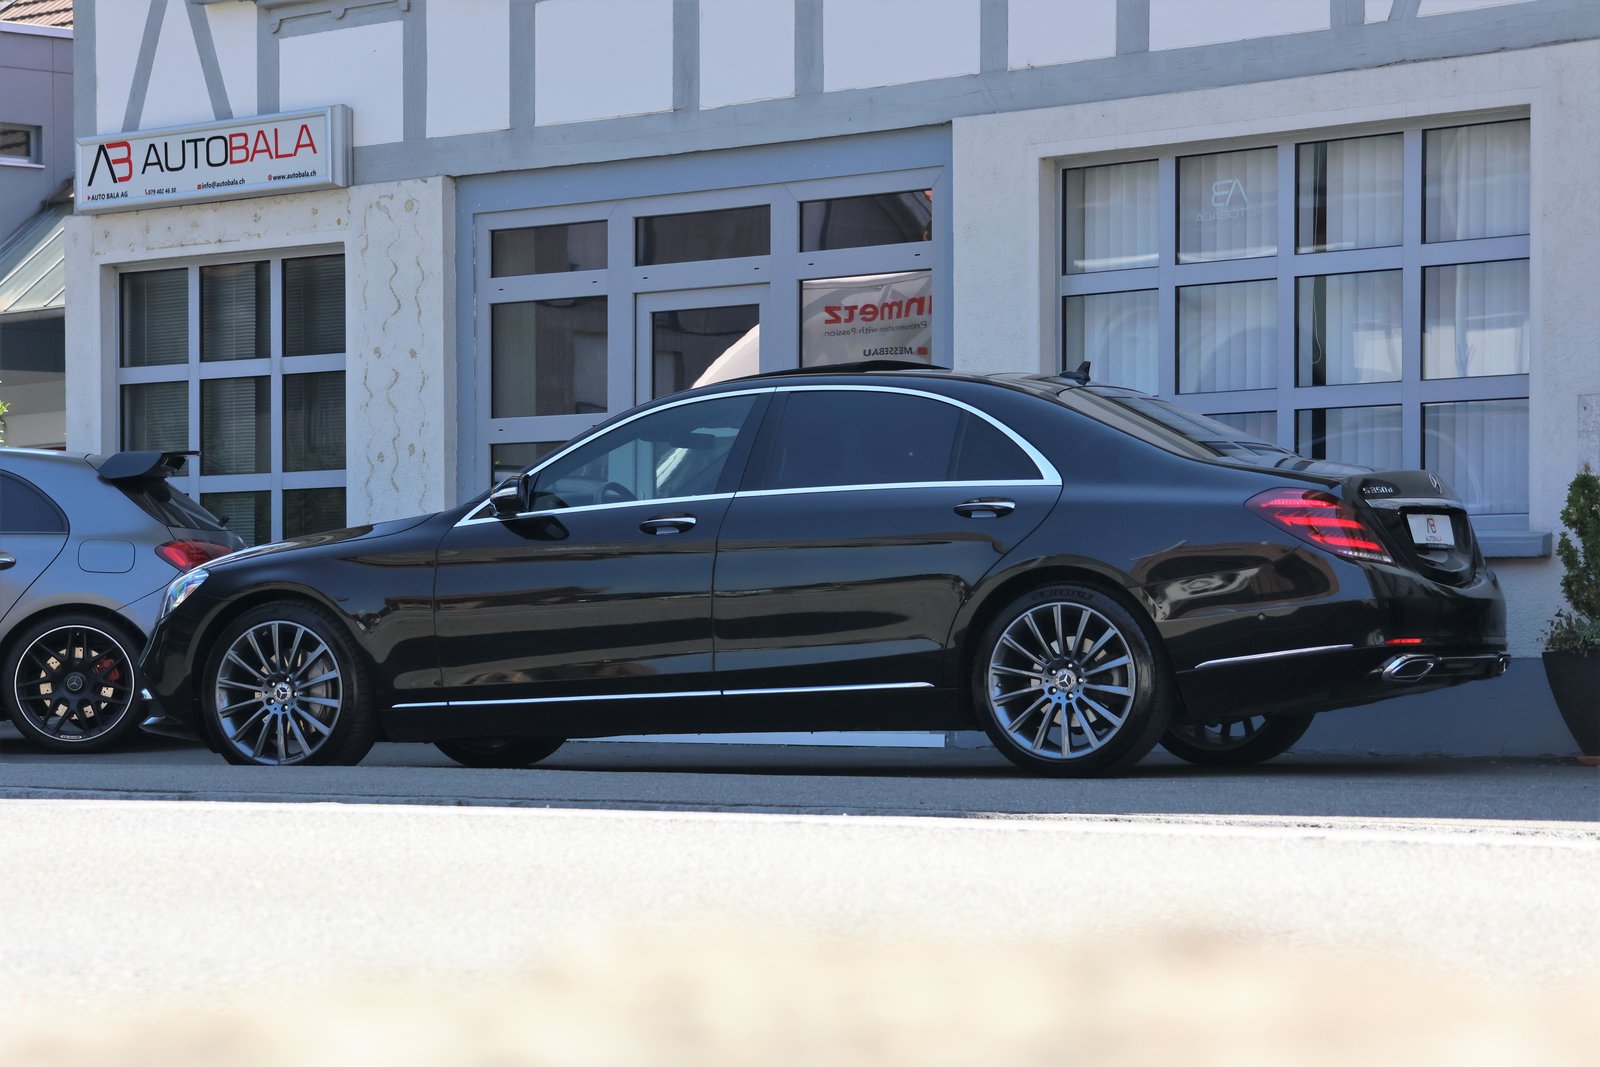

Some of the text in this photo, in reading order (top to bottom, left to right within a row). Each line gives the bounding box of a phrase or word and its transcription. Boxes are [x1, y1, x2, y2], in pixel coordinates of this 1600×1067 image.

[141, 124, 317, 175] AUTOBALA
[272, 170, 317, 181] www.autobala.ch
[201, 178, 246, 189] info@autobala.ch
